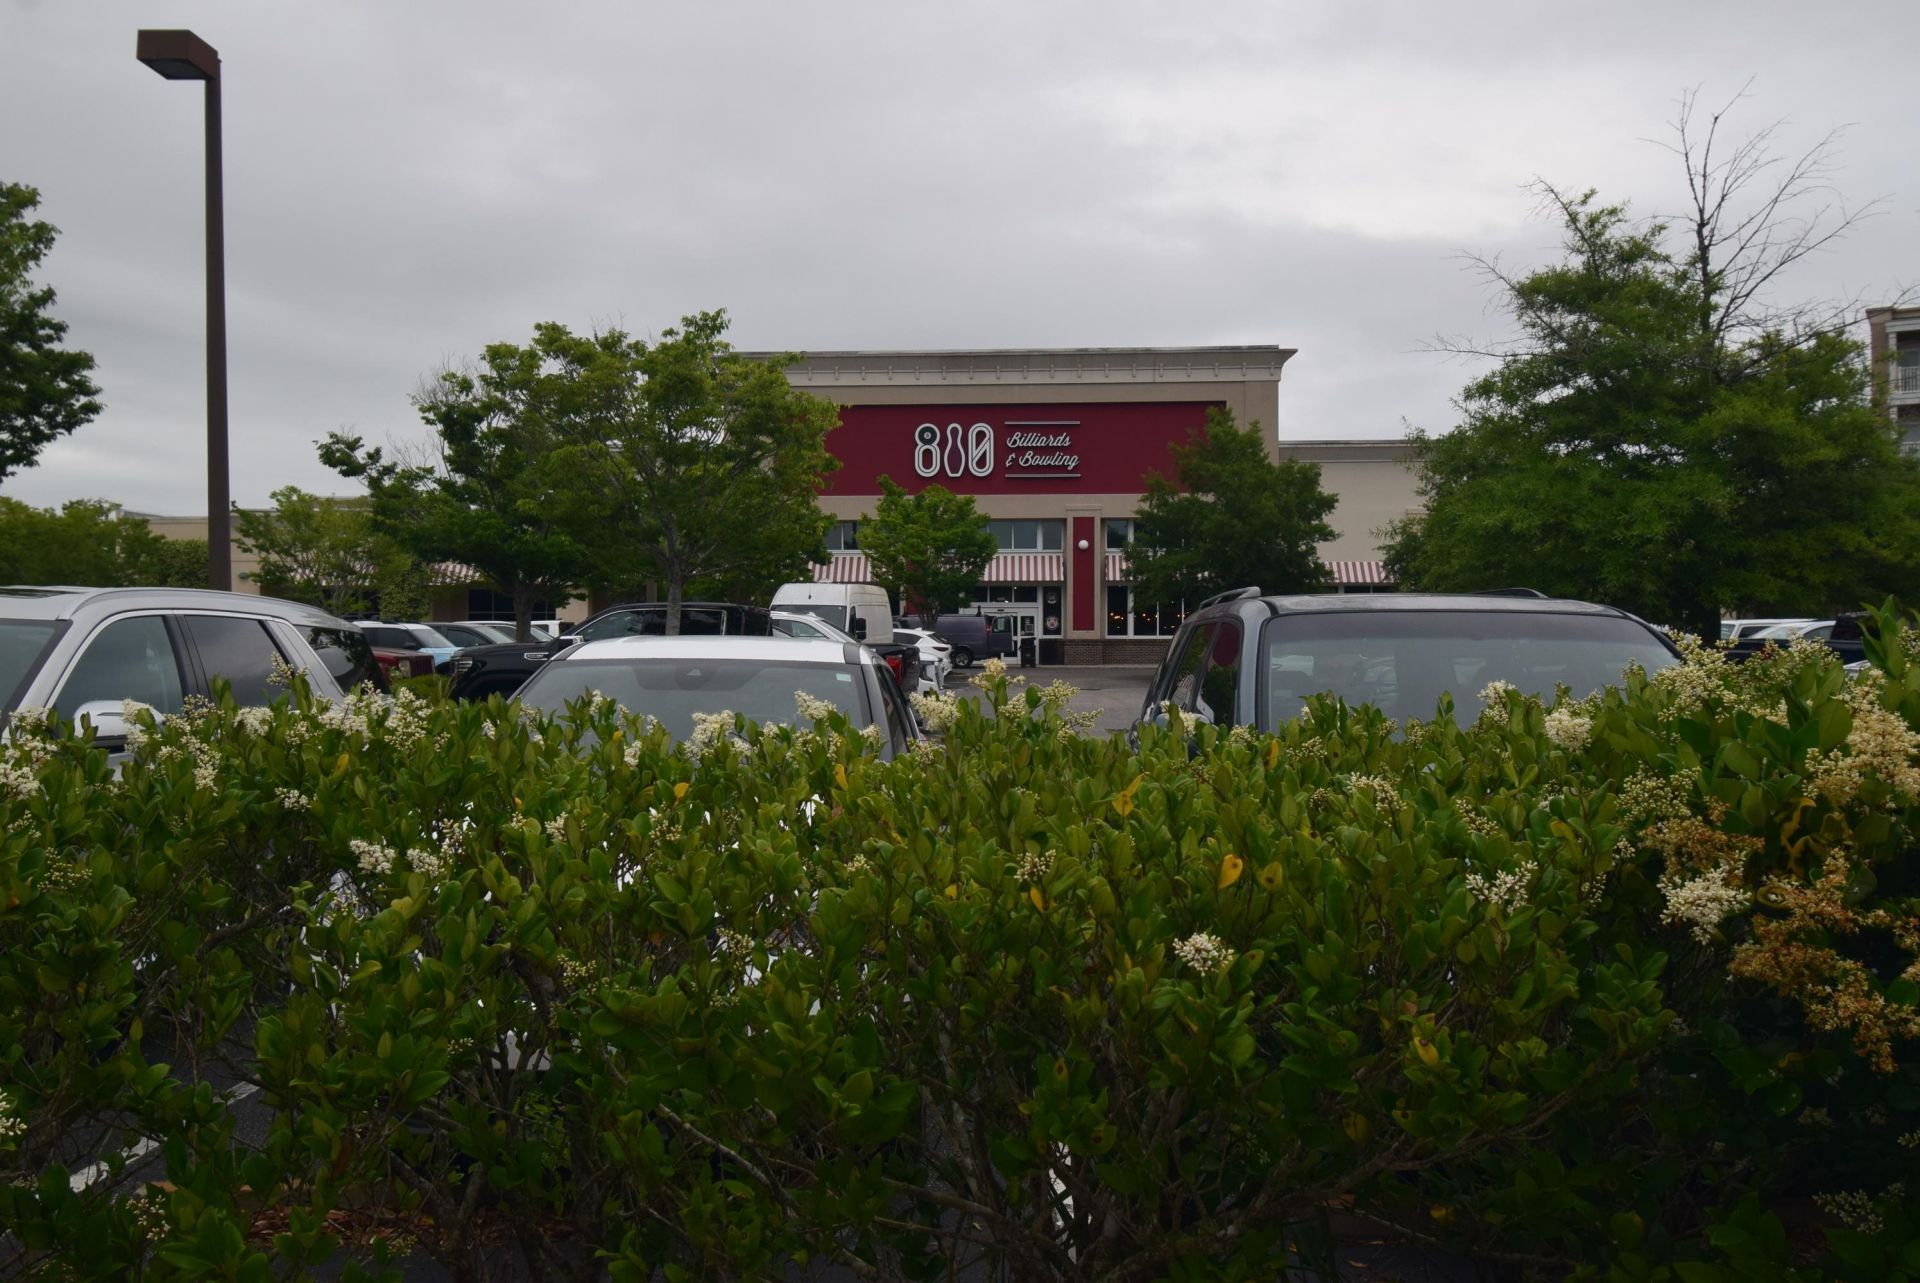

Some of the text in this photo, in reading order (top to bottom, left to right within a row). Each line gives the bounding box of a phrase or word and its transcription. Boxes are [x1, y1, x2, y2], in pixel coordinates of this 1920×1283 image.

[1006, 431, 1072, 448] Billiards
[1005, 450, 1080, 471] & Bowling
